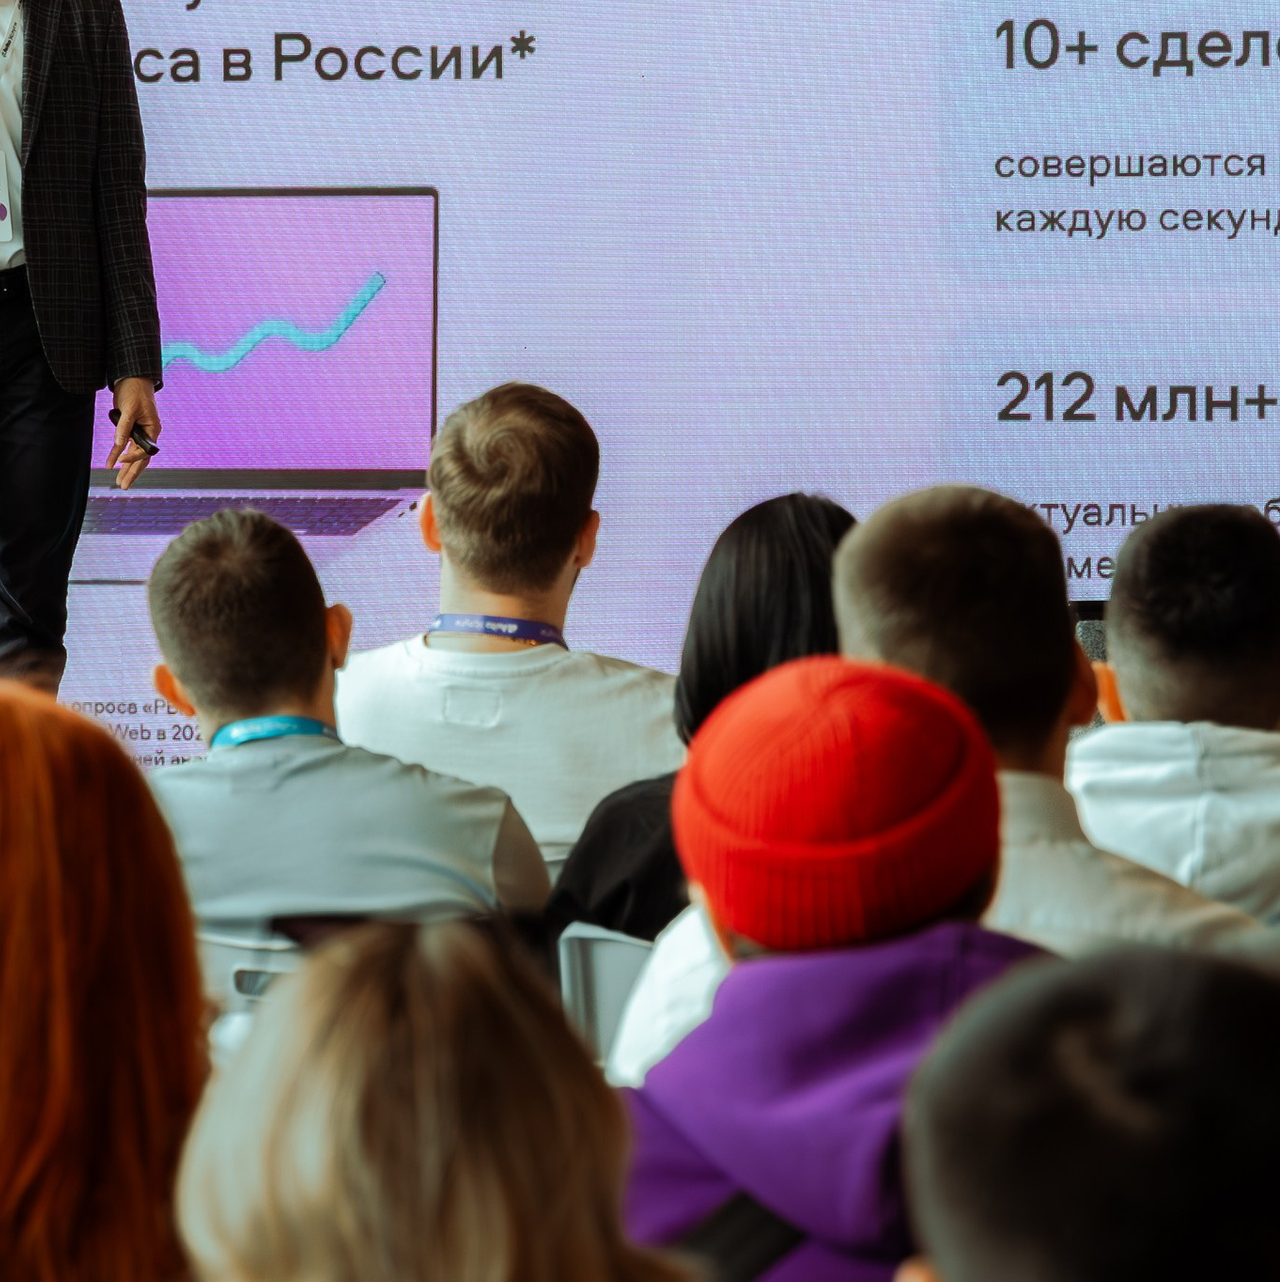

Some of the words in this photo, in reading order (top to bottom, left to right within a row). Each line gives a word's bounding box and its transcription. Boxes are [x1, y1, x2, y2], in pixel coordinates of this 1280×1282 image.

[996, 18, 1098, 70] 10+
[1116, 30, 1280, 77] сдел
[222, 48, 253, 82] в
[994, 154, 1266, 187] совершаются
[996, 209, 1147, 240] каждую
[1159, 209, 1280, 240] секун
[996, 370, 1096, 422] 212
[1115, 384, 1278, 422] млн+
